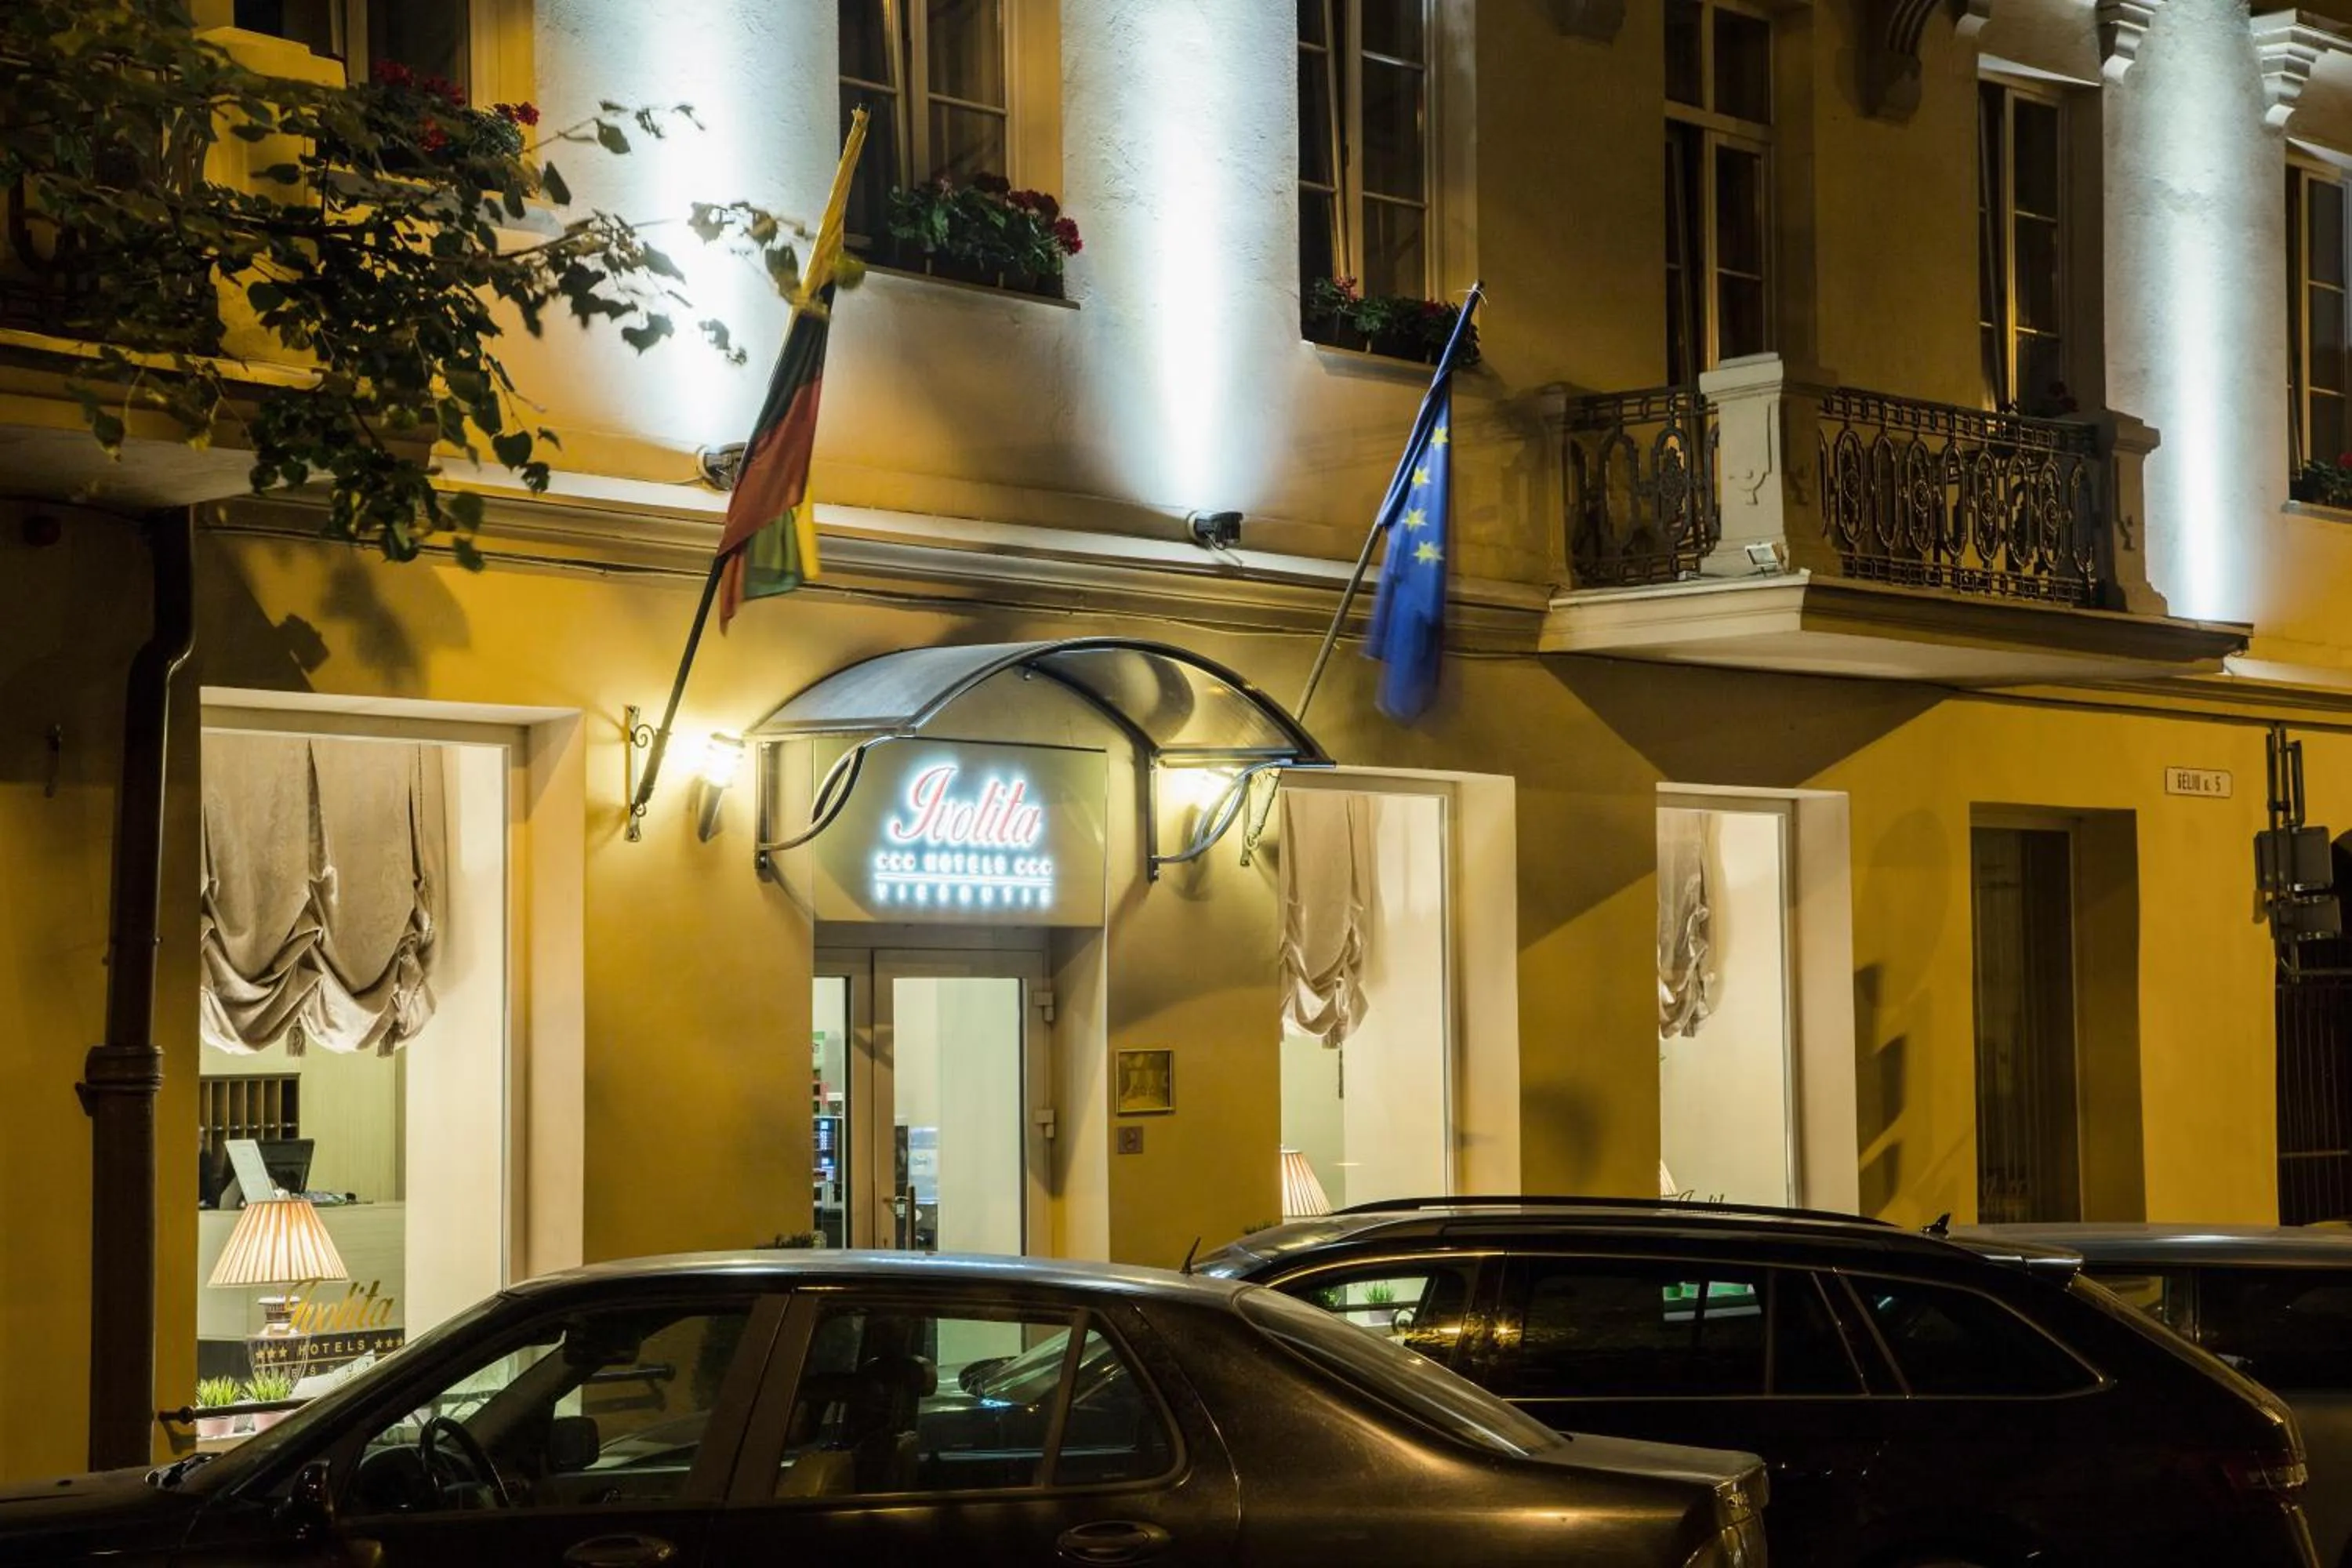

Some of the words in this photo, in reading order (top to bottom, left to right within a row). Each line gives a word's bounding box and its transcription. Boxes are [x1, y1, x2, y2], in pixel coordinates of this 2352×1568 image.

[2214, 775, 2222, 793] 5
[889, 764, 1042, 844] Ivolita
[924, 853, 1007, 875] HOTELS
[298, 1339, 365, 1356] HOTELS
